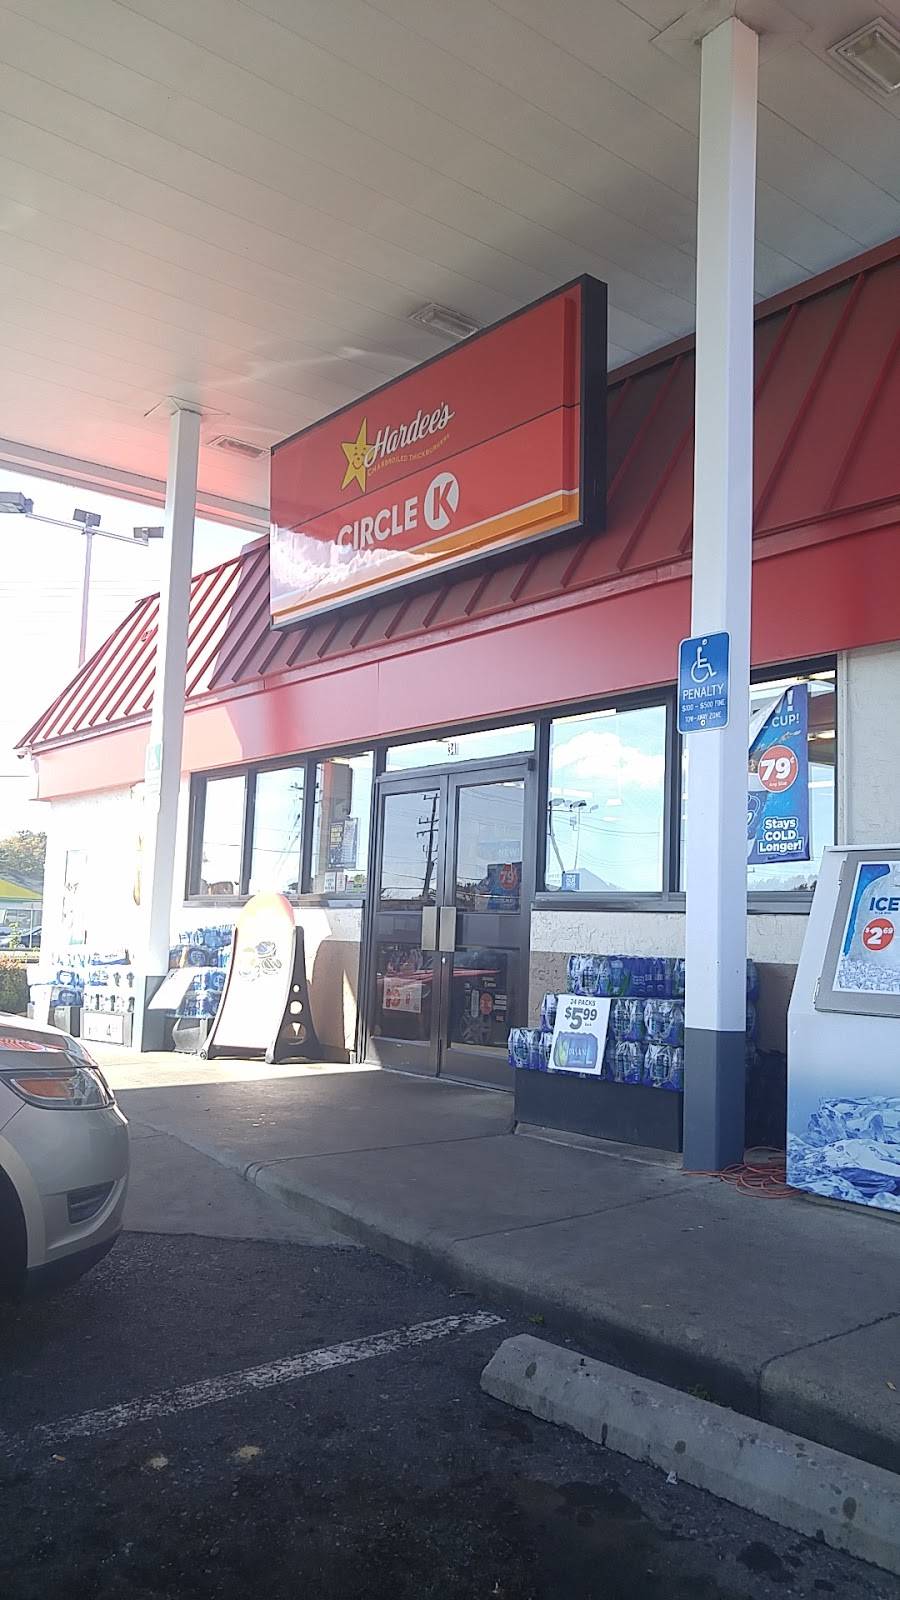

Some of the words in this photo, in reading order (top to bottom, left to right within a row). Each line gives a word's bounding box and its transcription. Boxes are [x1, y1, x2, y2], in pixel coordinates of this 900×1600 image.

[364, 401, 455, 468] Hardee's
[336, 496, 418, 552] CIRCLE
[427, 475, 459, 528] K
[682, 683, 725, 701] PENALTY
[771, 715, 801, 728] CUP!
[765, 817, 797, 830] Stays
[765, 829, 797, 842] COLD
[759, 839, 803, 853] Longer!
[869, 897, 900, 911] ICE
[577, 999, 596, 1007] PACKS
